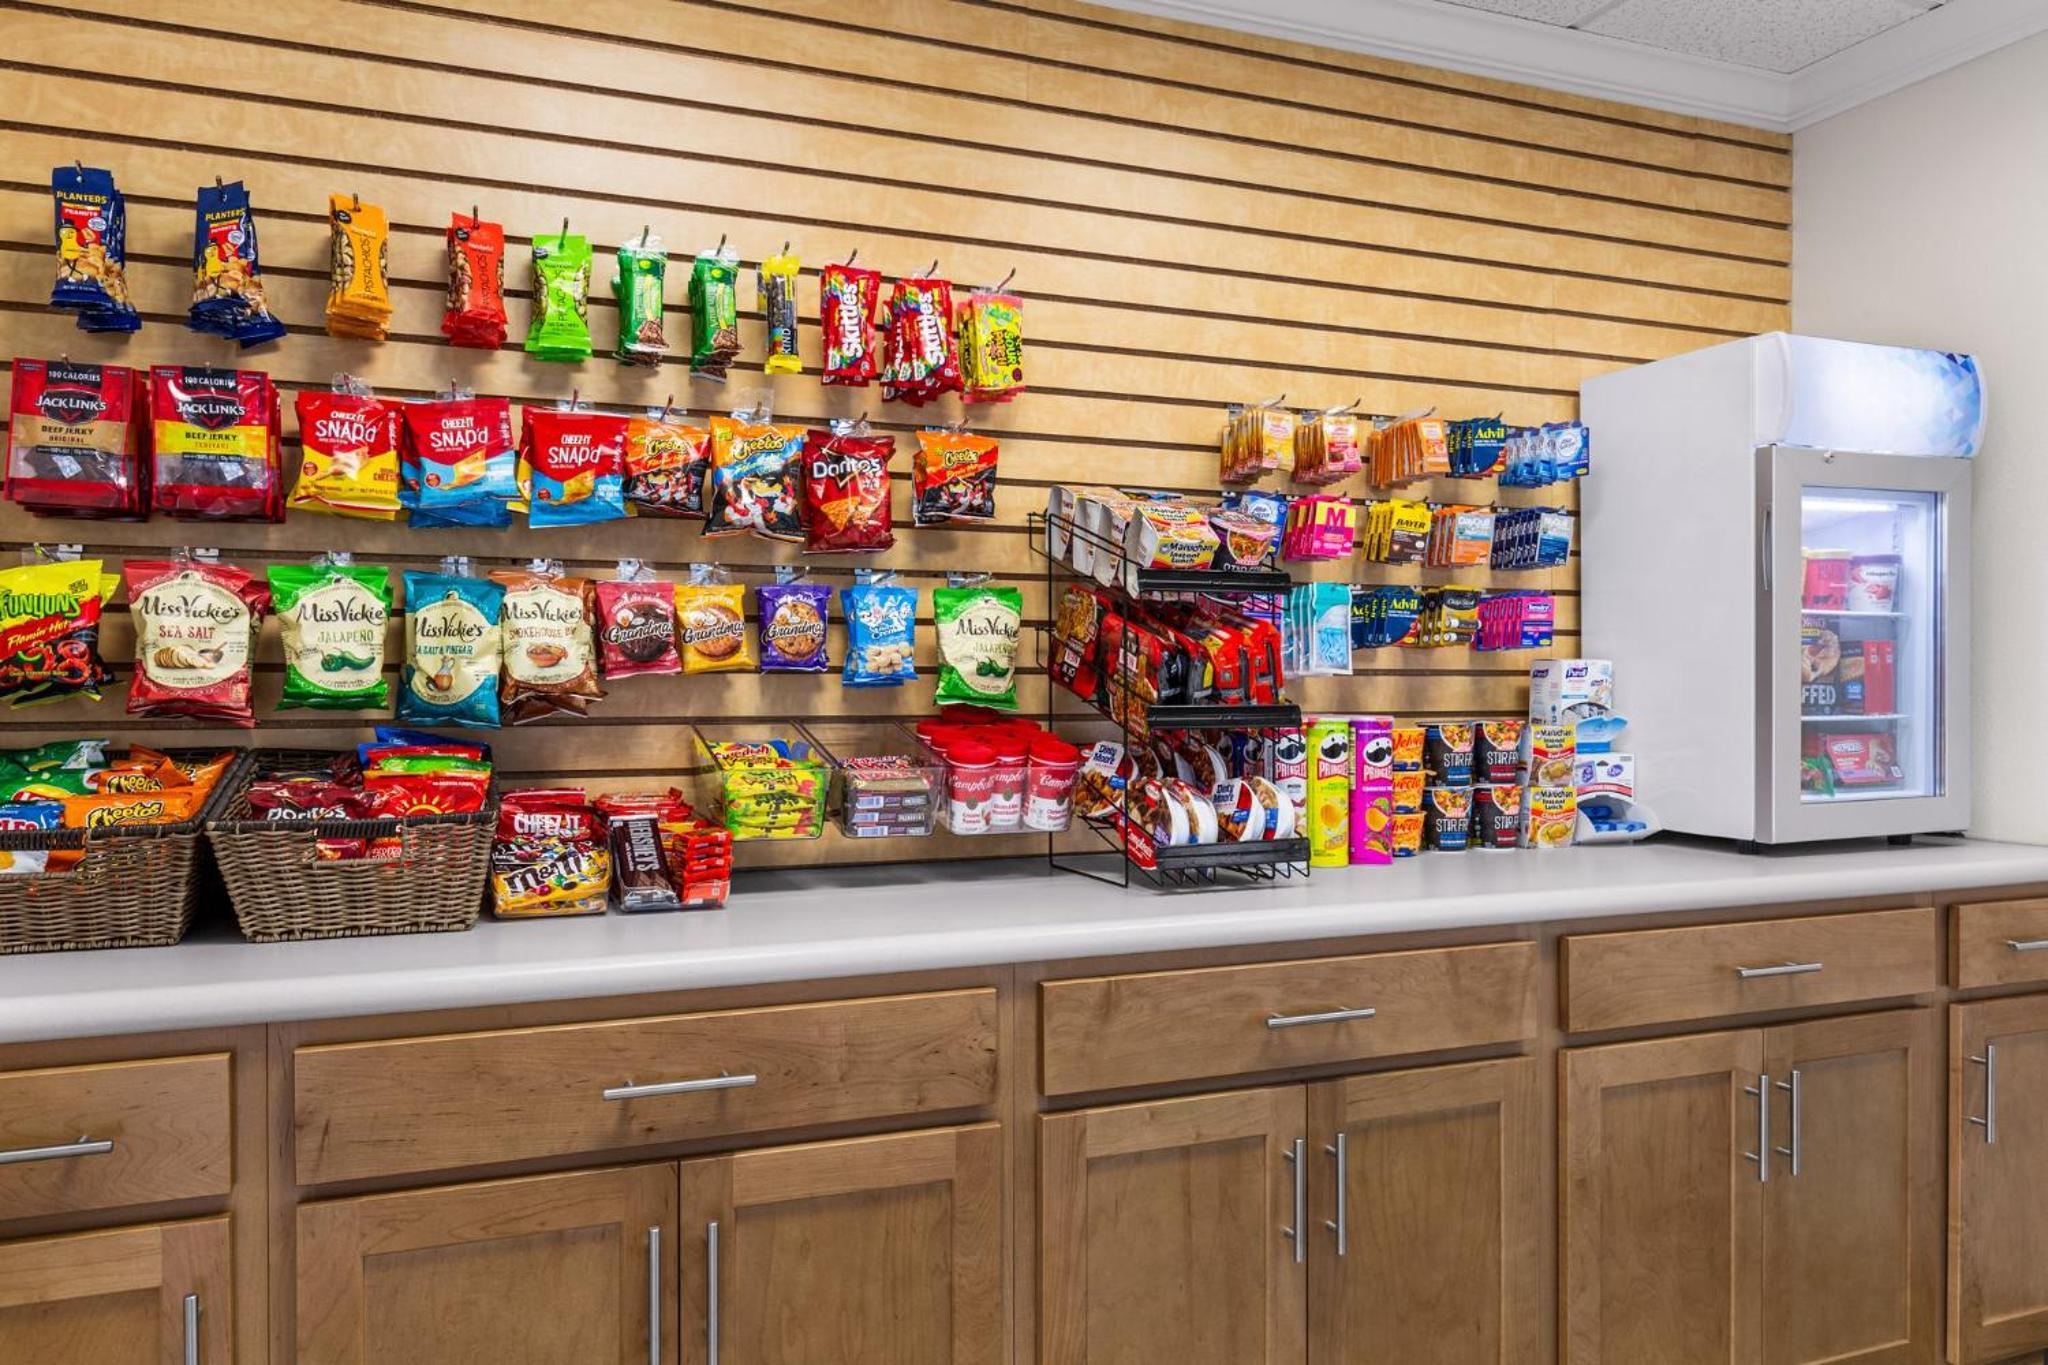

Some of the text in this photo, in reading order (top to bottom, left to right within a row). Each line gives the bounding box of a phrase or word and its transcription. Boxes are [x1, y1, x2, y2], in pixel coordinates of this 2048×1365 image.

[56, 190, 109, 205] PLANTERS
[204, 208, 247, 222] PLANTERS
[840, 283, 862, 358] Skittles
[917, 292, 945, 367] Skittles
[782, 327, 792, 356] KIND
[63, 371, 101, 382] CALORIES
[184, 376, 198, 385] 100
[35, 395, 69, 409] JACK
[176, 403, 208, 415] JACK
[41, 425, 94, 436] BEEF JERKY
[185, 432, 238, 442] BEEF JERKY
[1474, 428, 1505, 440] Advil
[732, 433, 786, 461] Cheetos
[812, 455, 882, 479] Doritos
[1396, 518, 1426, 530] BAYER
[1169, 542, 1213, 552] Maruchan
[140, 595, 241, 624] Miss Vickie's
[1390, 597, 1420, 611] Advil
[296, 602, 337, 625] Miss
[49, 620, 72, 633] Hot
[159, 624, 216, 640] SEA SALT
[440, 613, 484, 643] Vickie's
[955, 618, 991, 637] Miss
[1443, 752, 1464, 767] STIR
[1487, 750, 1509, 766] STIR
[1541, 790, 1573, 799] Maruchan
[87, 803, 163, 830] Cheetos
[266, 804, 347, 821] Doritos
[1435, 818, 1458, 833] STIR
